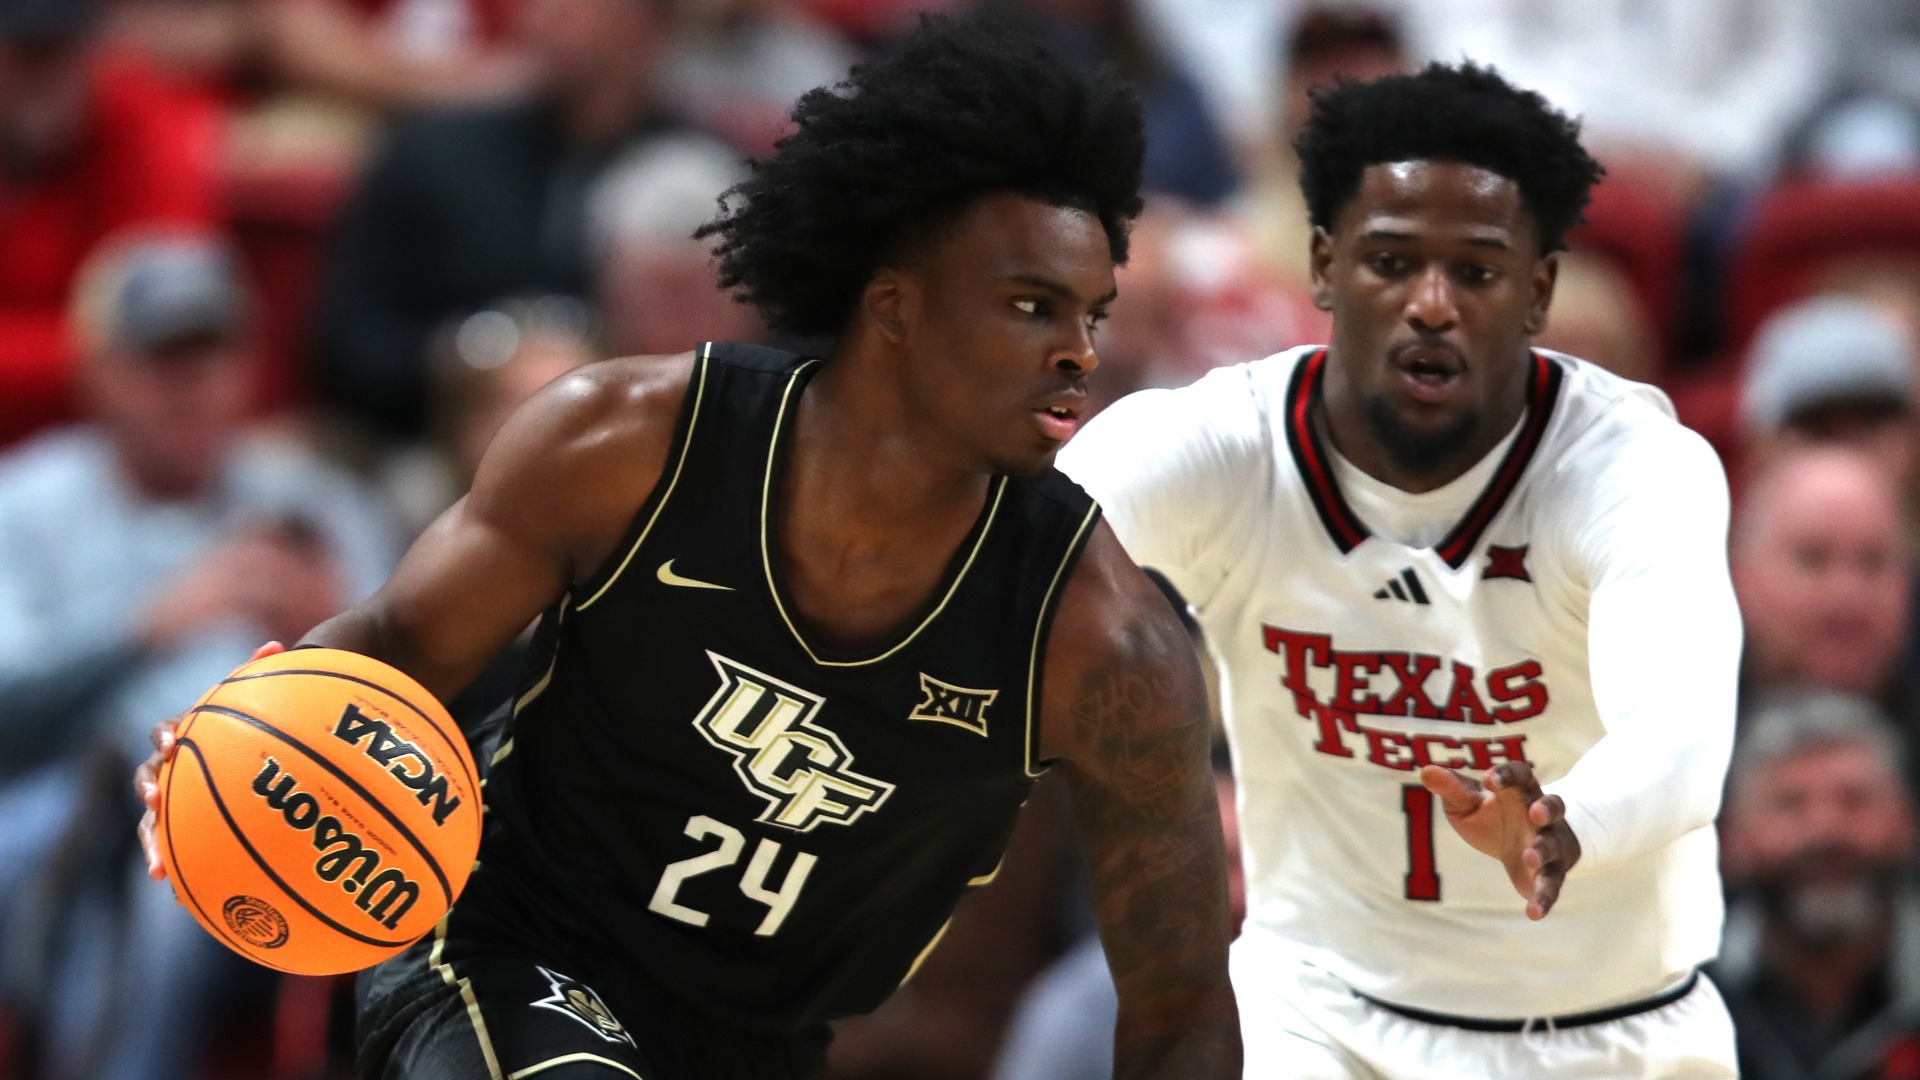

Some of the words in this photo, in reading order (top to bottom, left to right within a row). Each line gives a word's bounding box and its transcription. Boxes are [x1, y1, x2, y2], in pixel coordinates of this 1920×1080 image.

[1261, 624, 1549, 725] TEXAS
[1292, 695, 1534, 771] TECH
[333, 703, 462, 827] NCAA
[700, 657, 888, 830] UCF
[252, 757, 420, 930] Wilson
[648, 815, 818, 936] 24
[1402, 783, 1441, 901] 1
